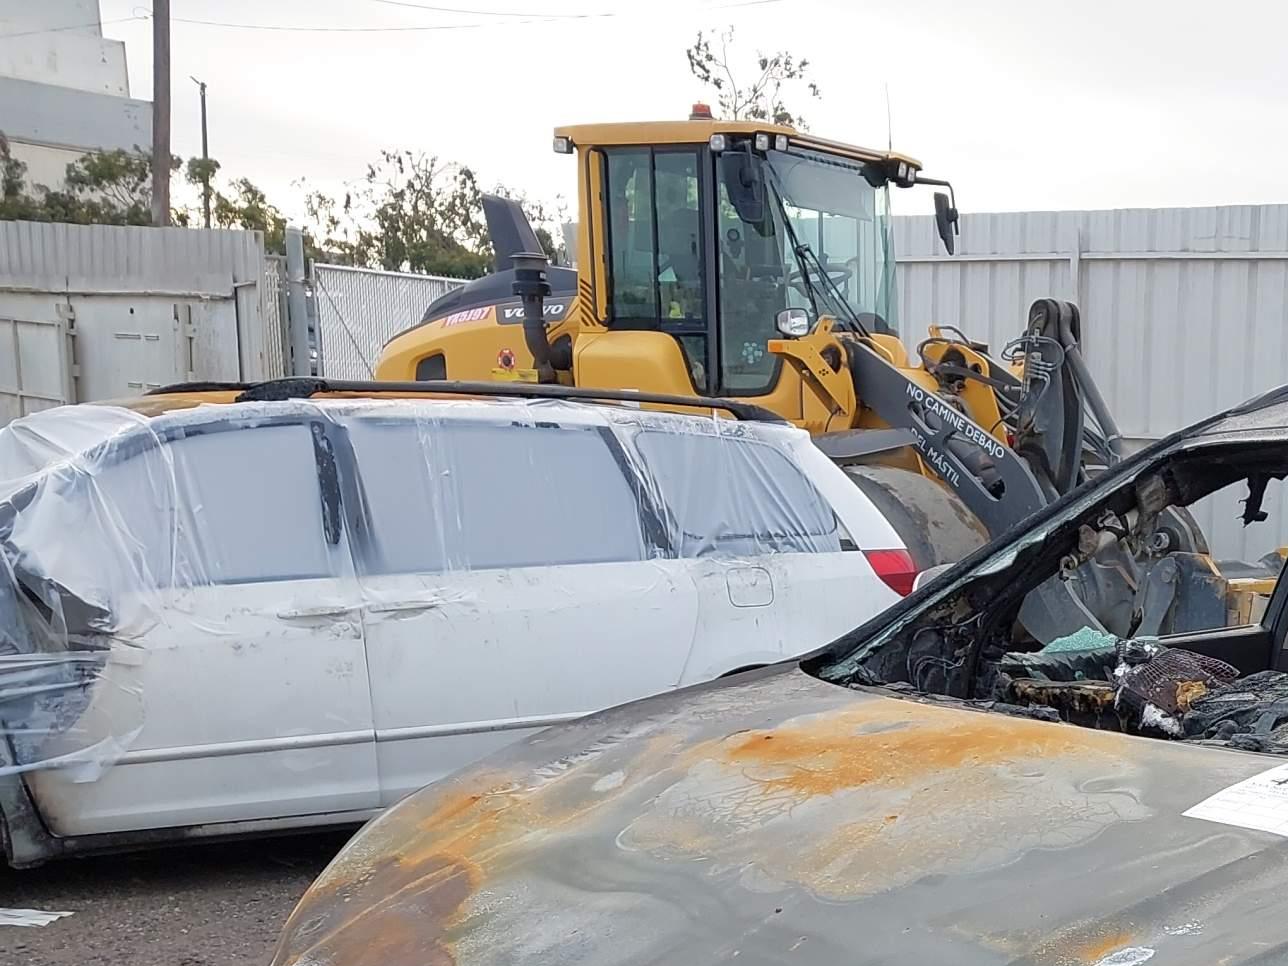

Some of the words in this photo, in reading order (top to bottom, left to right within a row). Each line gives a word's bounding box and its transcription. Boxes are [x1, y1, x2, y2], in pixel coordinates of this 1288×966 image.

[504, 304, 564, 319] VOVO
[906, 383, 924, 401] NO
[925, 398, 965, 431] CAMINE
[965, 425, 1005, 459] DEBAJO
[927, 447, 960, 488] MÁSTIL
